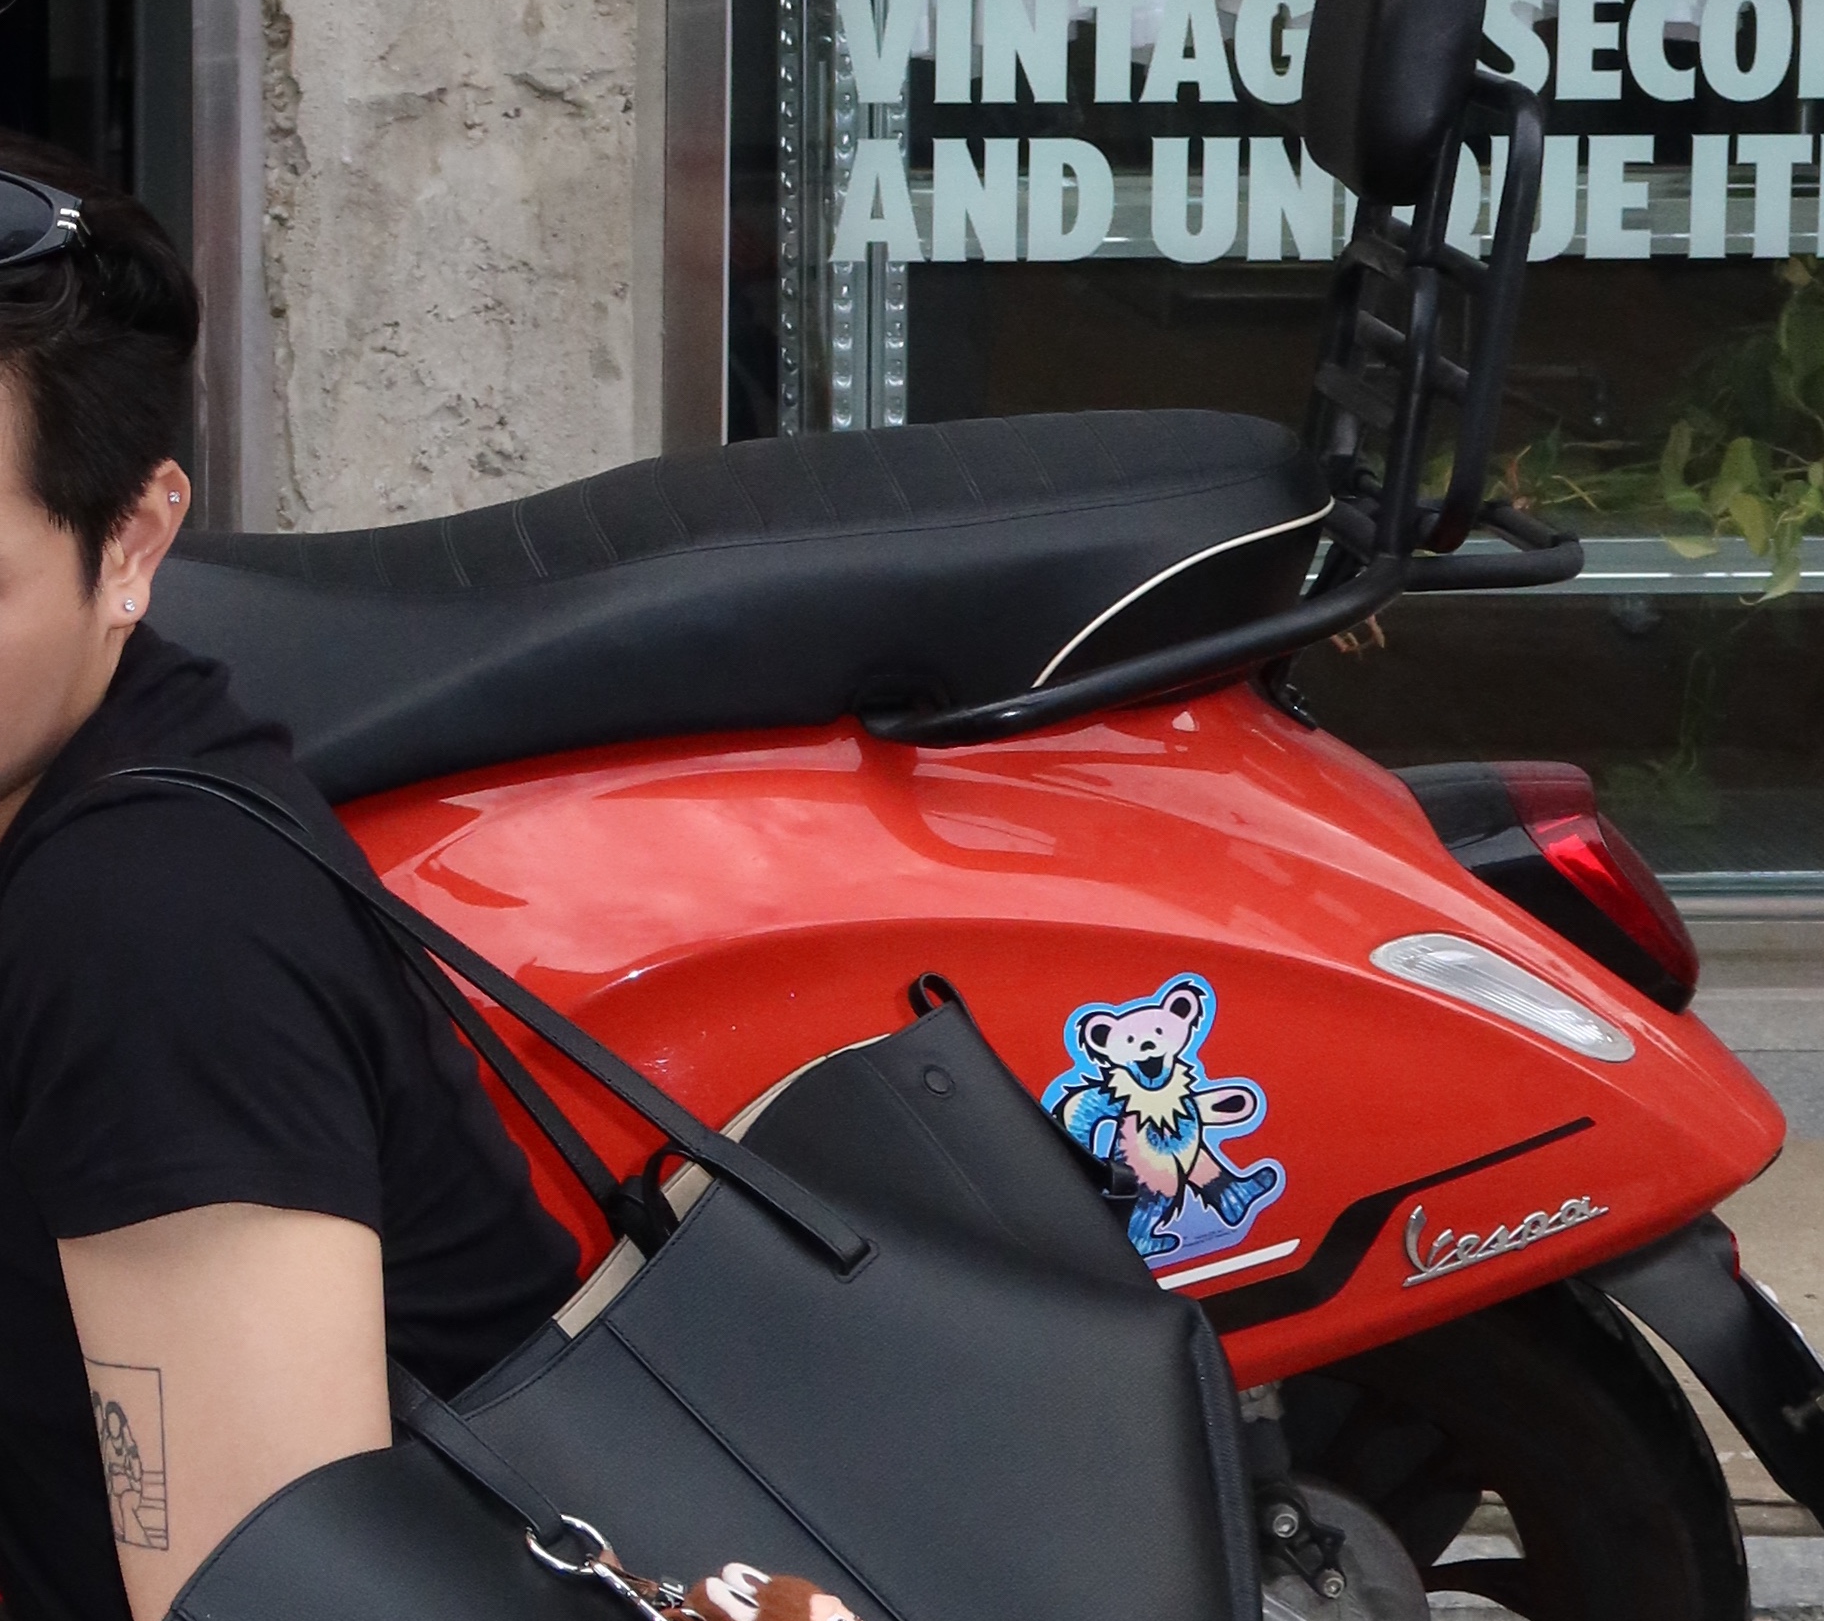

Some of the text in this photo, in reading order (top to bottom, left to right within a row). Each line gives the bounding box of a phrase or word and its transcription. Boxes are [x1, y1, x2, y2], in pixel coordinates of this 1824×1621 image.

[829, 134, 1824, 264] AND UNUE IT
[1403, 1196, 1609, 1287] Vespa
